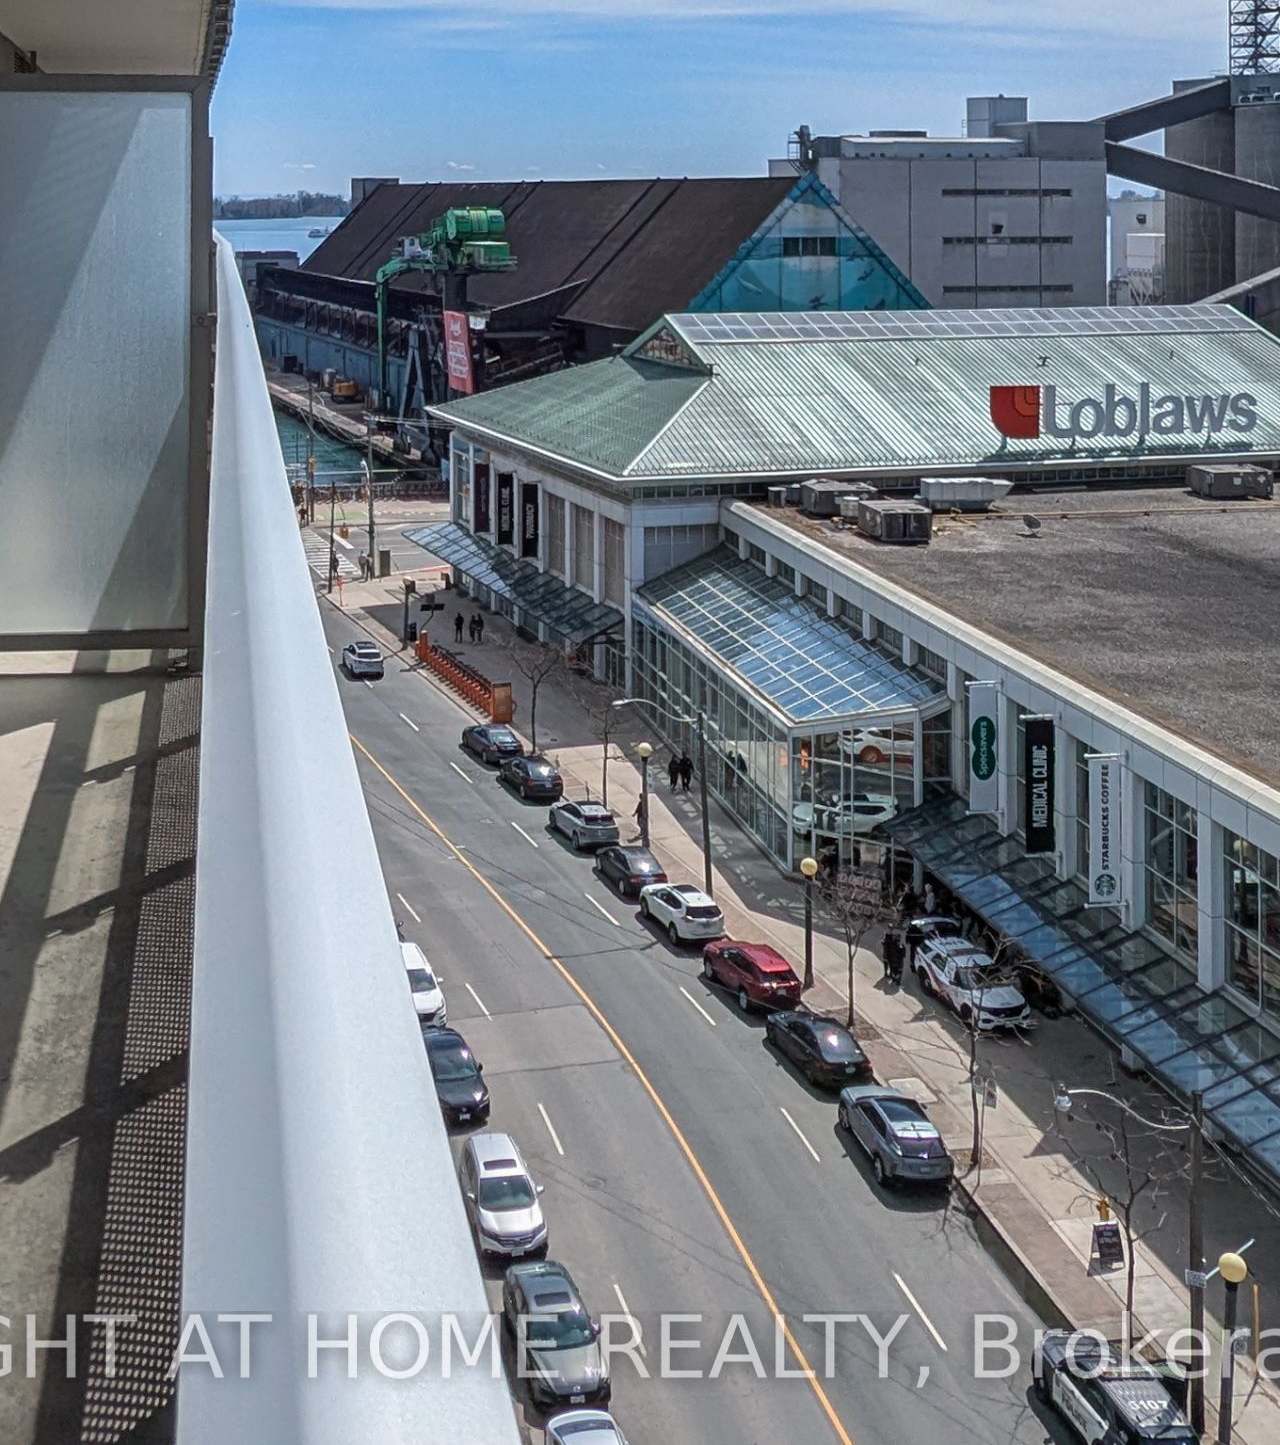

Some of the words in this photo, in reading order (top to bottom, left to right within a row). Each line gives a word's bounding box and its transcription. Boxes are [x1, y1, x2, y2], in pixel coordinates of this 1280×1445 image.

[1042, 382, 1258, 439] Loblaws
[978, 721, 990, 776] Specsavers
[1032, 745, 1048, 778] CLINIC
[1032, 780, 1048, 828] MEDICAL
[1101, 764, 1110, 804] COFFEE
[1101, 806, 1110, 871] STARBUCKS
